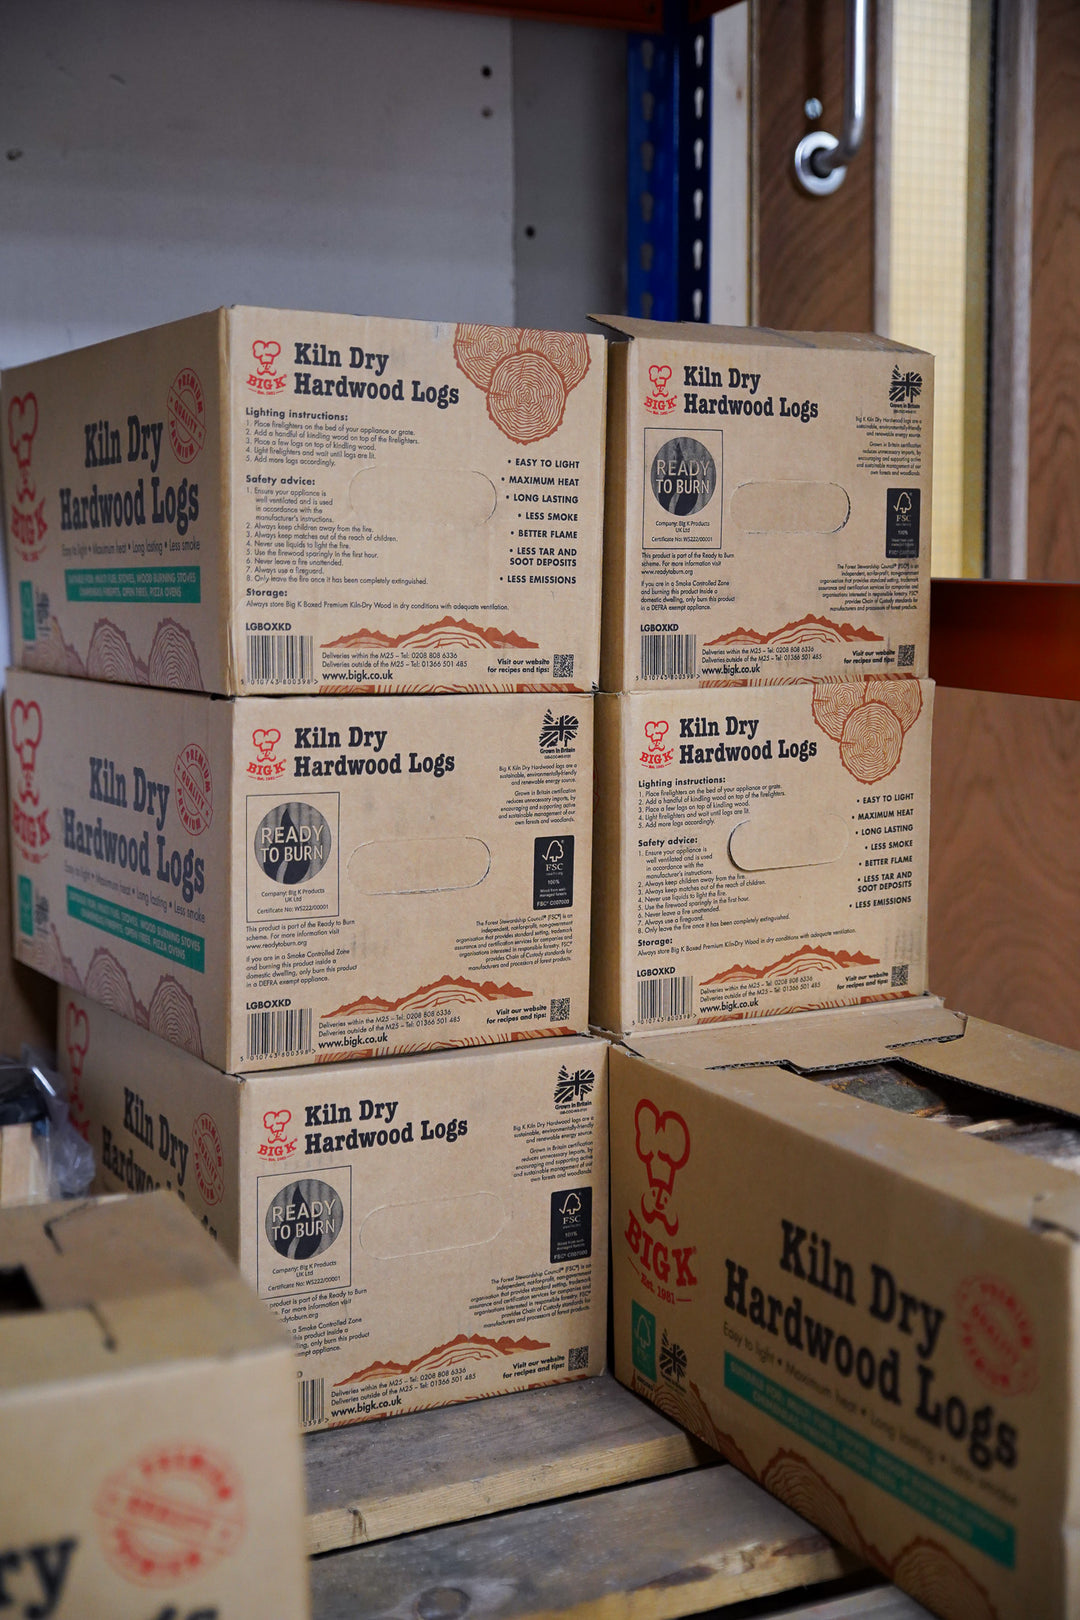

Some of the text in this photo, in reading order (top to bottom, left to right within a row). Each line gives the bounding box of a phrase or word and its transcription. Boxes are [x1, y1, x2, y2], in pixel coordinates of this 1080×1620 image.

[294, 342, 390, 376] Kiln Dry
[683, 365, 761, 395] Kiln Dry
[294, 372, 459, 409] Hardwood Logs
[246, 407, 348, 421] Lighting instructions:
[684, 393, 818, 423] Hardwood Logs
[84, 415, 162, 472] Kiln Dry
[515, 458, 580, 469] EASY TO LIGHT
[657, 460, 710, 476] READY
[246, 475, 315, 486] Safety advice:
[509, 476, 579, 486] MAXIMUM HEAT
[656, 480, 710, 494] TO BURN
[514, 493, 579, 504] LONG LASTING
[60, 477, 199, 536] Hardwood Logs
[526, 512, 578, 521] LESS SMOKE
[518, 529, 578, 539] BETTER FLAME
[517, 547, 577, 556] LESS TAR AND
[510, 557, 577, 567] SOOT DEPOSITS
[507, 575, 576, 584] LESS EMISSIONS
[246, 588, 287, 599] Storage:
[246, 622, 292, 631] LGBOXKD
[640, 624, 679, 632] LGBOXKD
[322, 669, 393, 683] www.bigk.co.uk
[498, 666, 521, 675] recipes
[536, 666, 550, 674] tips:
[701, 663, 760, 676] www.bigk.co.uk
[679, 716, 759, 740] Kiln Dry
[294, 726, 387, 753] Kiln Dry
[679, 739, 817, 764] Hardwood Logs
[294, 752, 455, 778] Hardwood Logs
[638, 776, 726, 790] Lighting instructions:
[90, 756, 170, 831] Kiln Dry
[863, 796, 881, 804] EASY
[894, 793, 914, 801] LIGHT
[858, 808, 914, 820] MAXIMUM HEAT
[261, 825, 324, 844] READY
[861, 824, 913, 836] LONG LASTING
[638, 836, 698, 848] Safety advice:
[871, 839, 913, 851] LESS SMOKE
[63, 807, 205, 902] Hardwood Logs
[260, 845, 322, 862] TO BURN
[546, 863, 564, 872] FSC
[865, 855, 913, 867] BETTER FLAME
[864, 874, 879, 883] LESS
[896, 871, 912, 879] AND
[858, 880, 912, 893] SOOT DEPOSITS
[855, 895, 912, 909] LESS EMISSIONS
[638, 938, 673, 947] Storage:
[637, 966, 676, 977] LGBOXKD
[246, 998, 291, 1010] LGBOXKD
[699, 998, 759, 1013] www.bigk.co.uk
[318, 1033, 388, 1049] www.bigk.co.uk
[304, 1101, 399, 1127] Kiln Dry
[124, 1086, 154, 1150] Kiln
[159, 1114, 188, 1186] Dry
[304, 1120, 468, 1155] Hardwood Logs
[272, 1199, 336, 1222] READY
[272, 1218, 334, 1240] TO BURN
[779, 1218, 856, 1307] Kiln
[870, 1264, 945, 1360] Dry
[724, 1258, 902, 1406] Hardwood
[916, 1363, 1018, 1471] Logs
[331, 1397, 402, 1417] www.bigk.co.uk
